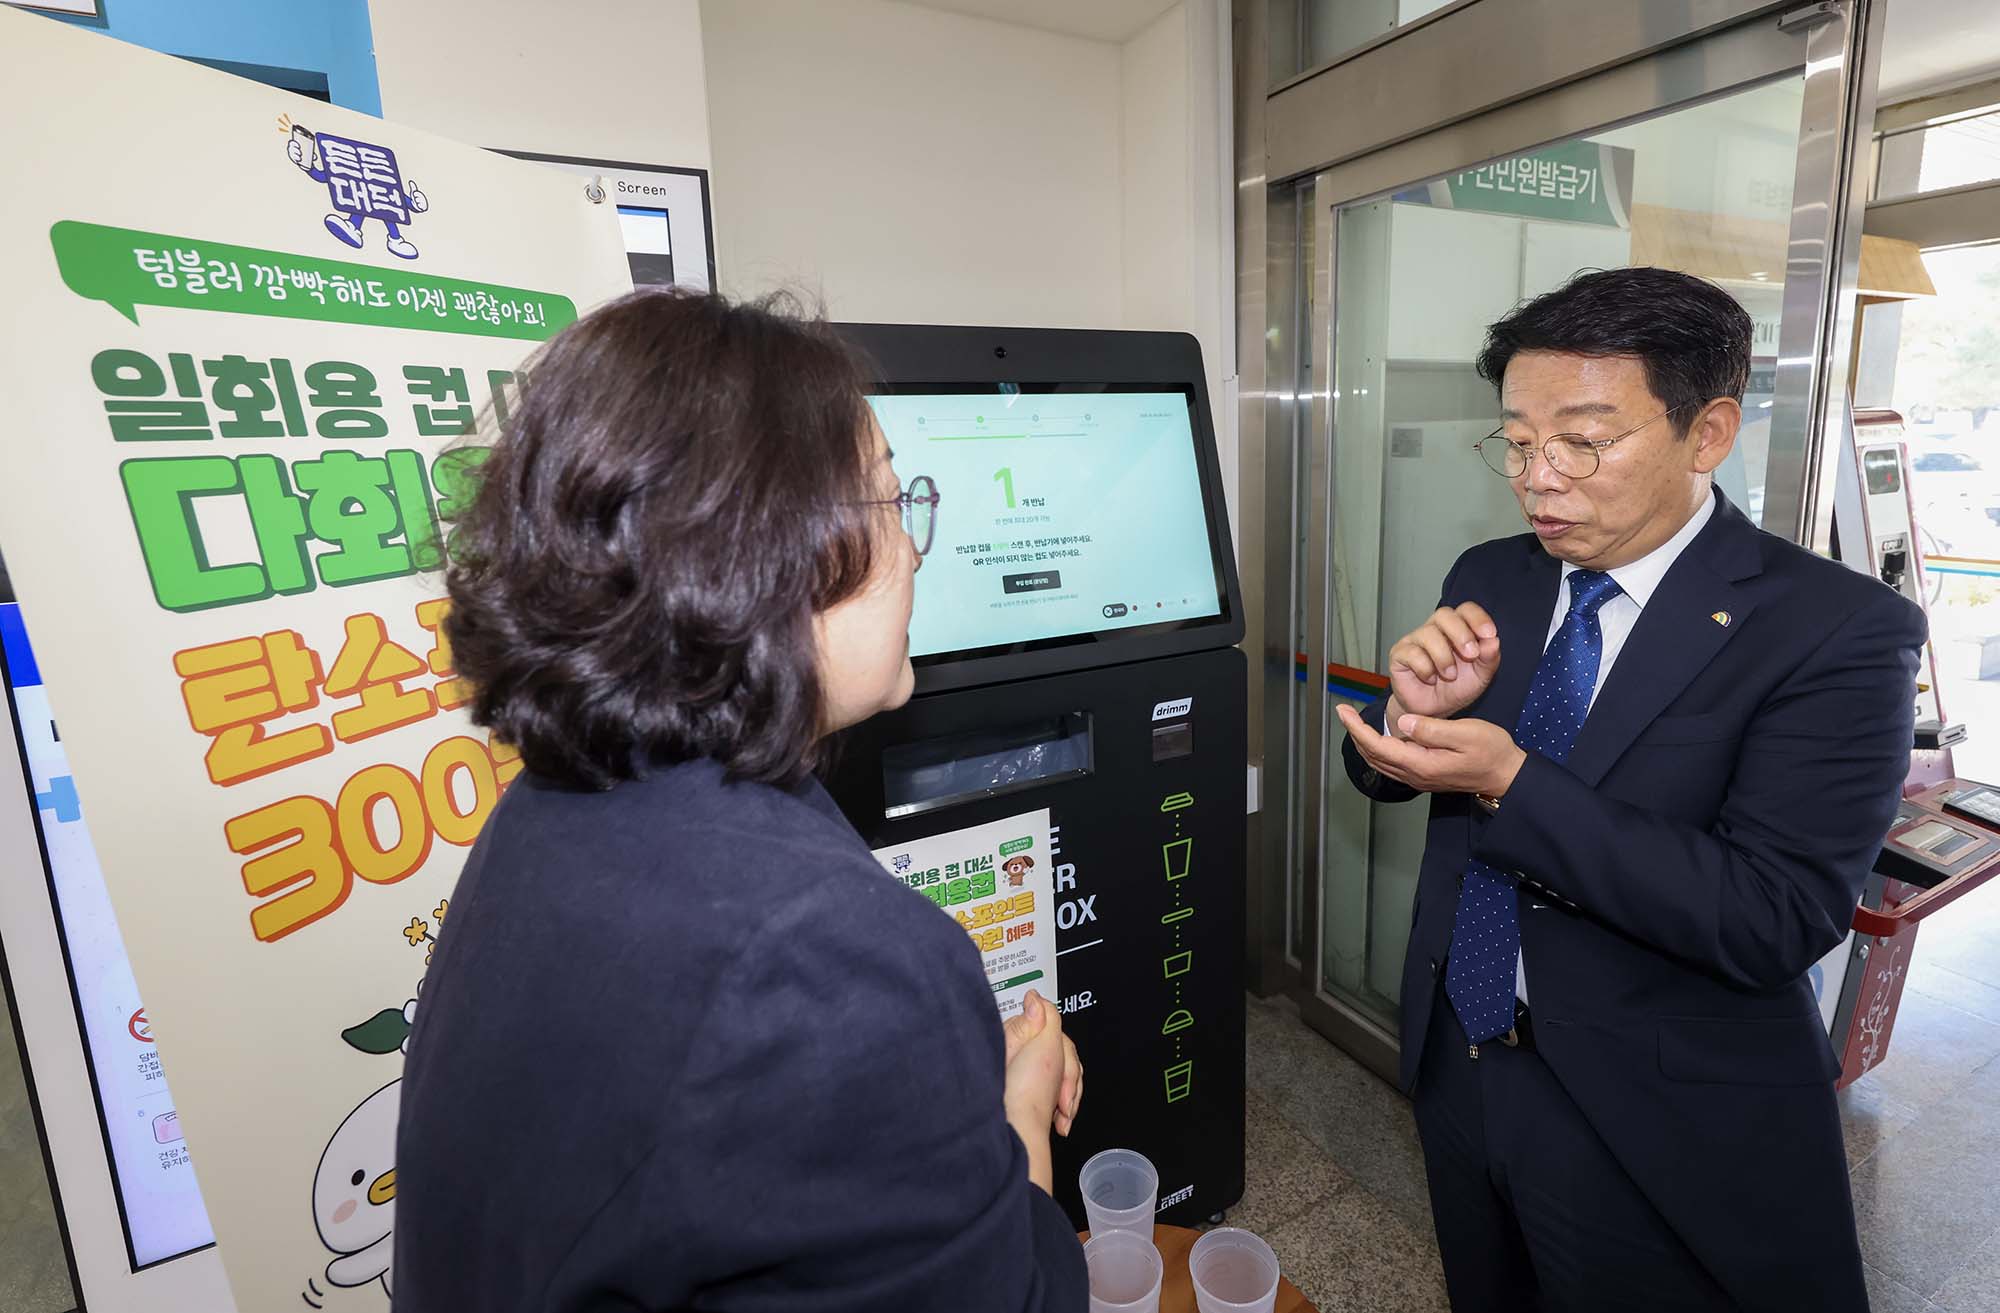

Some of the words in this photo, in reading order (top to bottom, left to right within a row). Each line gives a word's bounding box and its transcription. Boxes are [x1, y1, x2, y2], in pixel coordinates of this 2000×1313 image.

[329, 176, 406, 222] 대덕
[617, 180, 667, 196] Screen
[133, 248, 244, 295] 텀블러
[248, 263, 392, 308] 깜빡해도
[396, 286, 448, 318] 이젠
[451, 290, 548, 327] 괜찮아요!
[91, 348, 389, 442] 일회용
[402, 365, 478, 436] 컵
[994, 466, 1016, 509] 1
[1031, 496, 1046, 507] 반납
[1034, 537, 1060, 547] 반납기에
[1060, 534, 1093, 544] 넣어주세요.
[973, 557, 984, 566] QR
[985, 555, 1006, 566] 인식이
[1006, 553, 1020, 563] 되지
[1021, 552, 1034, 562] 않는
[1035, 551, 1048, 561] 컵도
[1049, 548, 1082, 560] 넣어주세요.
[1156, 704, 1188, 716] drimm
[945, 862, 960, 880] 컵
[964, 854, 994, 875] 대신
[1052, 862, 1076, 894] R
[1056, 894, 1098, 930] OX
[1006, 920, 1035, 944] 혜택
[1161, 1187, 1194, 1210] GREET
